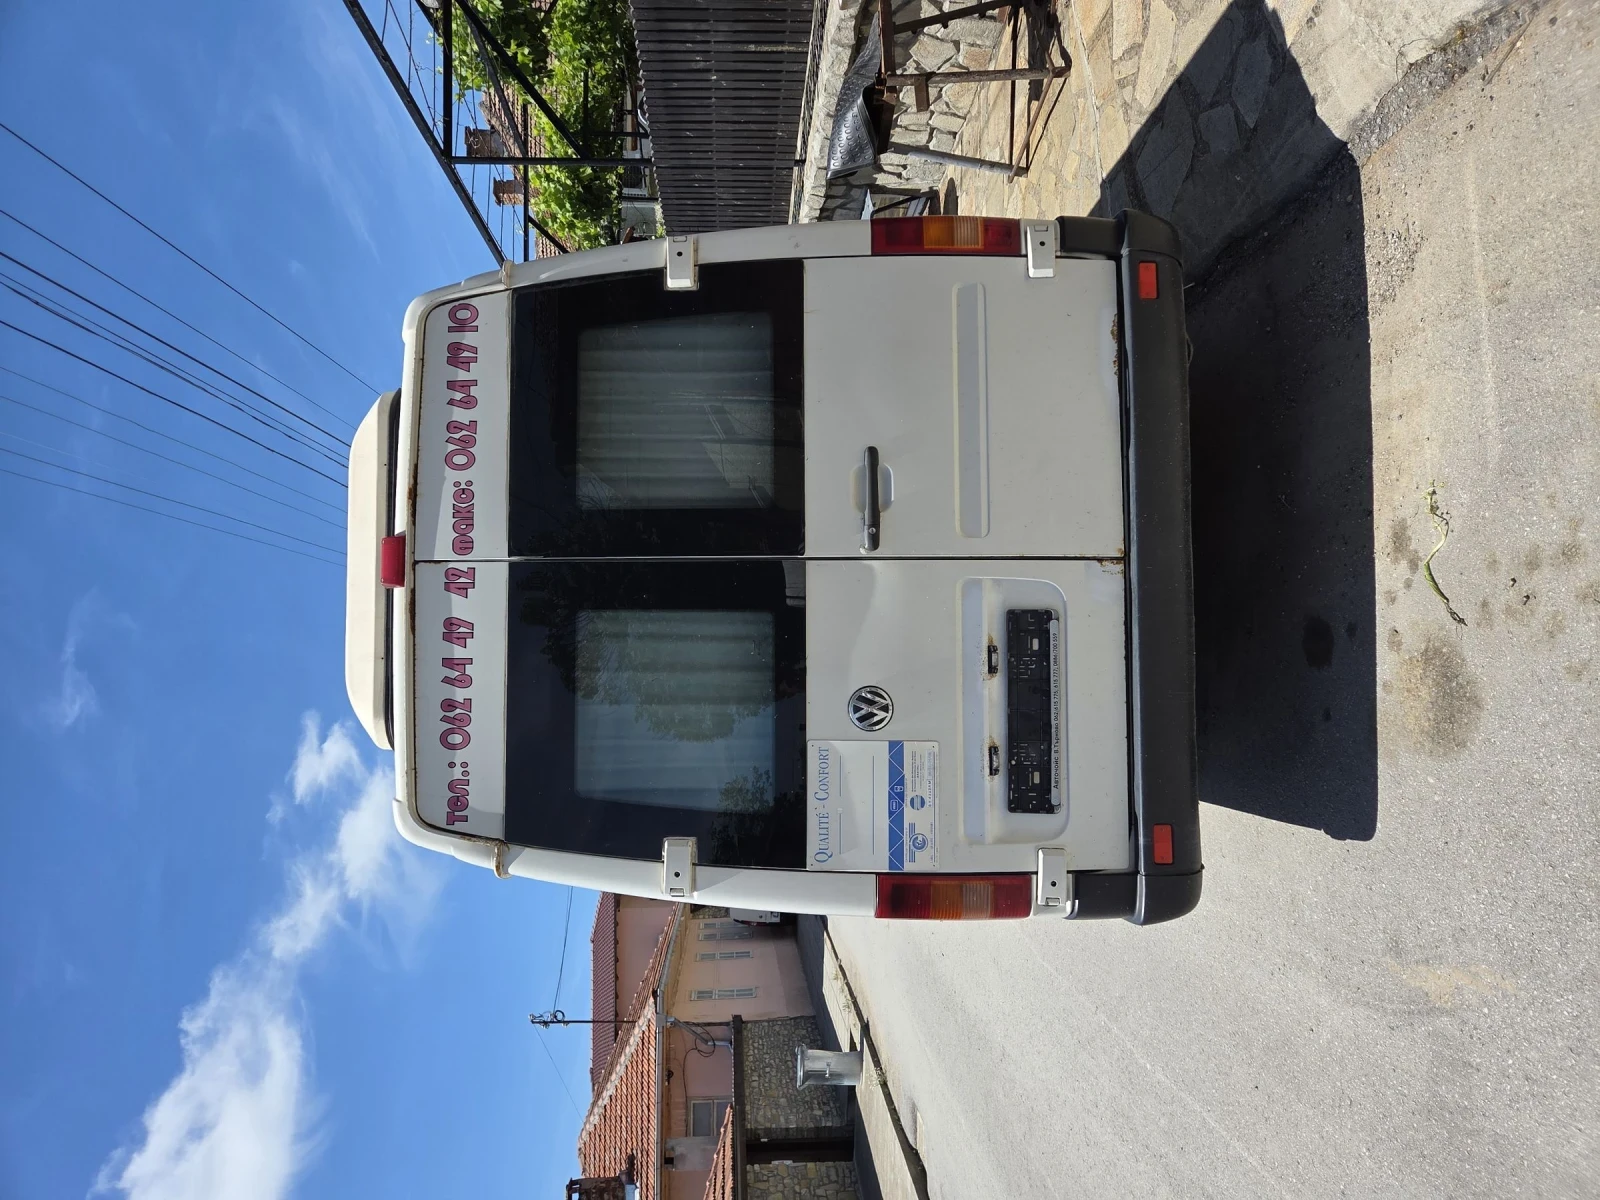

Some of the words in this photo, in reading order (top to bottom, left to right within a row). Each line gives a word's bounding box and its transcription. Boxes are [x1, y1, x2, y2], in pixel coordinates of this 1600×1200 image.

[447, 303, 479, 333] 10
[447, 341, 478, 372] 49
[446, 379, 478, 410] 64
[444, 420, 477, 471] 062
[444, 567, 475, 599] 42
[442, 616, 474, 649] 49
[441, 658, 473, 689] 64
[440, 698, 471, 750] 062
[814, 746, 830, 801] CONFORT
